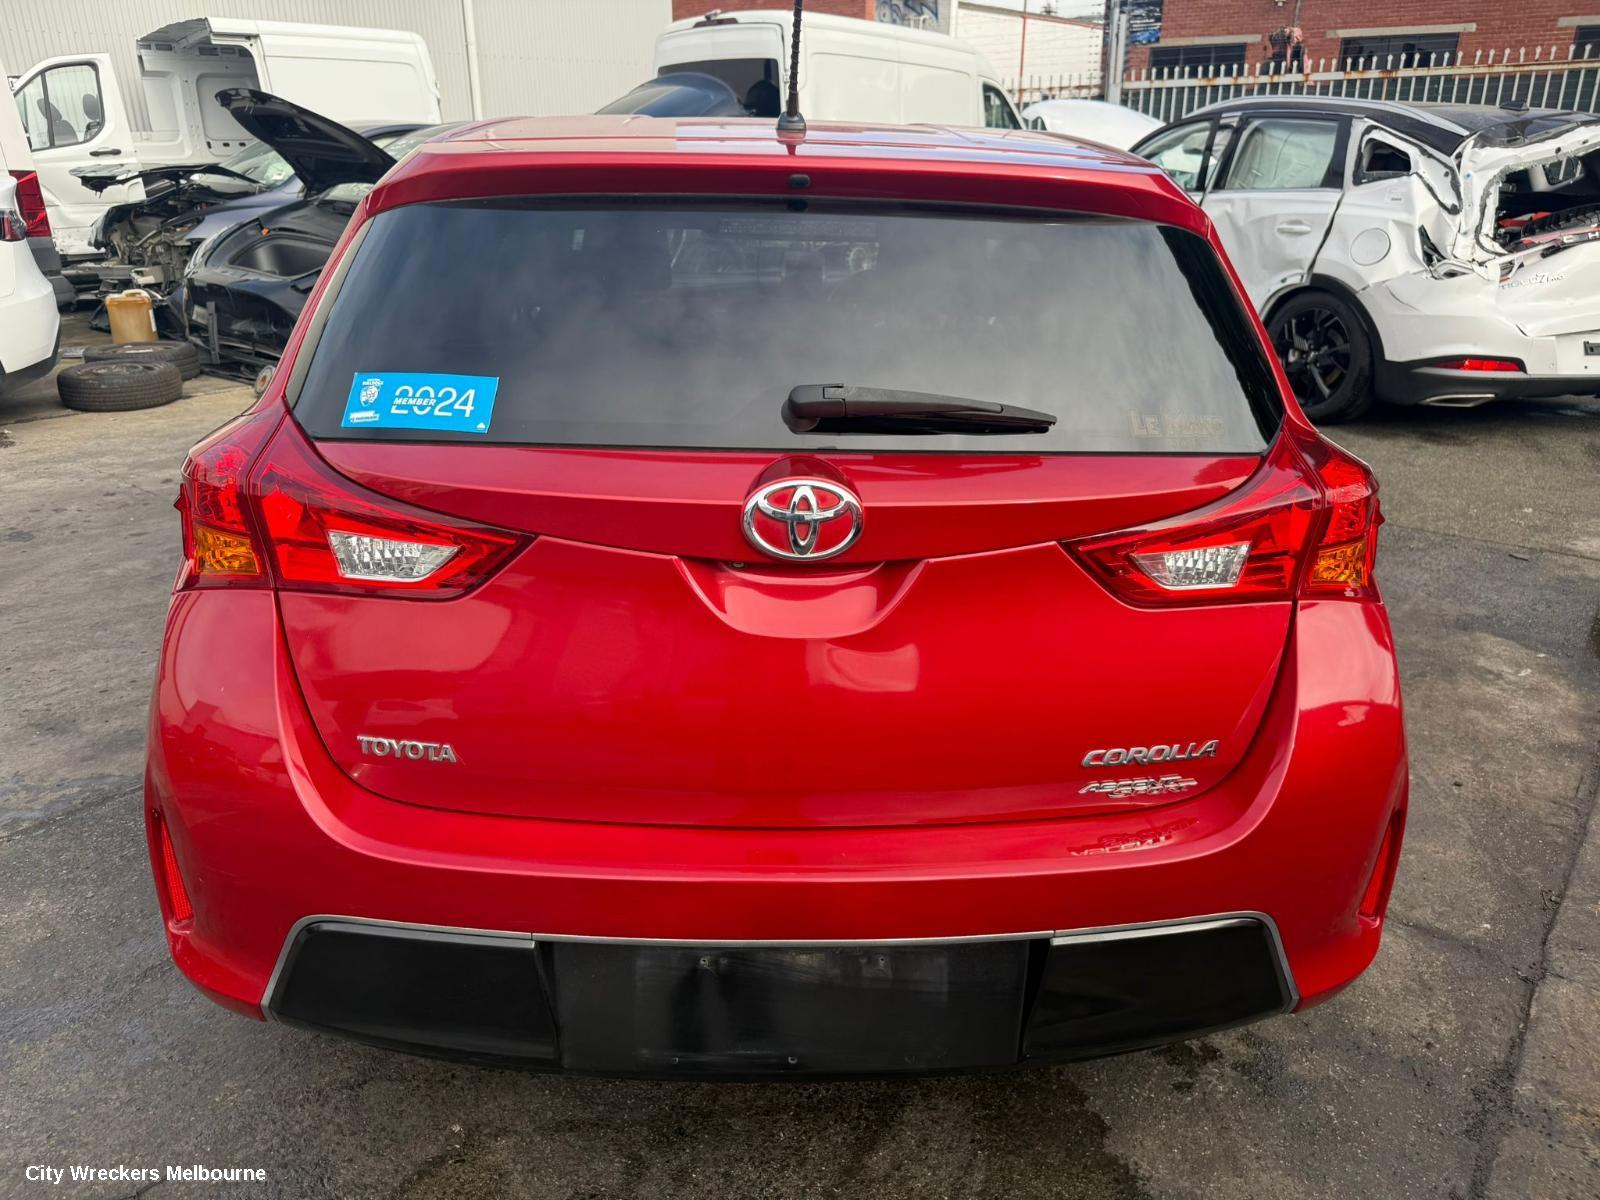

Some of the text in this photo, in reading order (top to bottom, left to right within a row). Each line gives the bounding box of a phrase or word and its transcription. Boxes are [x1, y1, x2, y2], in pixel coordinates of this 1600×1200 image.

[390, 385, 476, 418] 2024
[393, 397, 437, 406] MEMBER
[356, 735, 457, 763] TOYOTA
[1080, 739, 1220, 768] COROLLA
